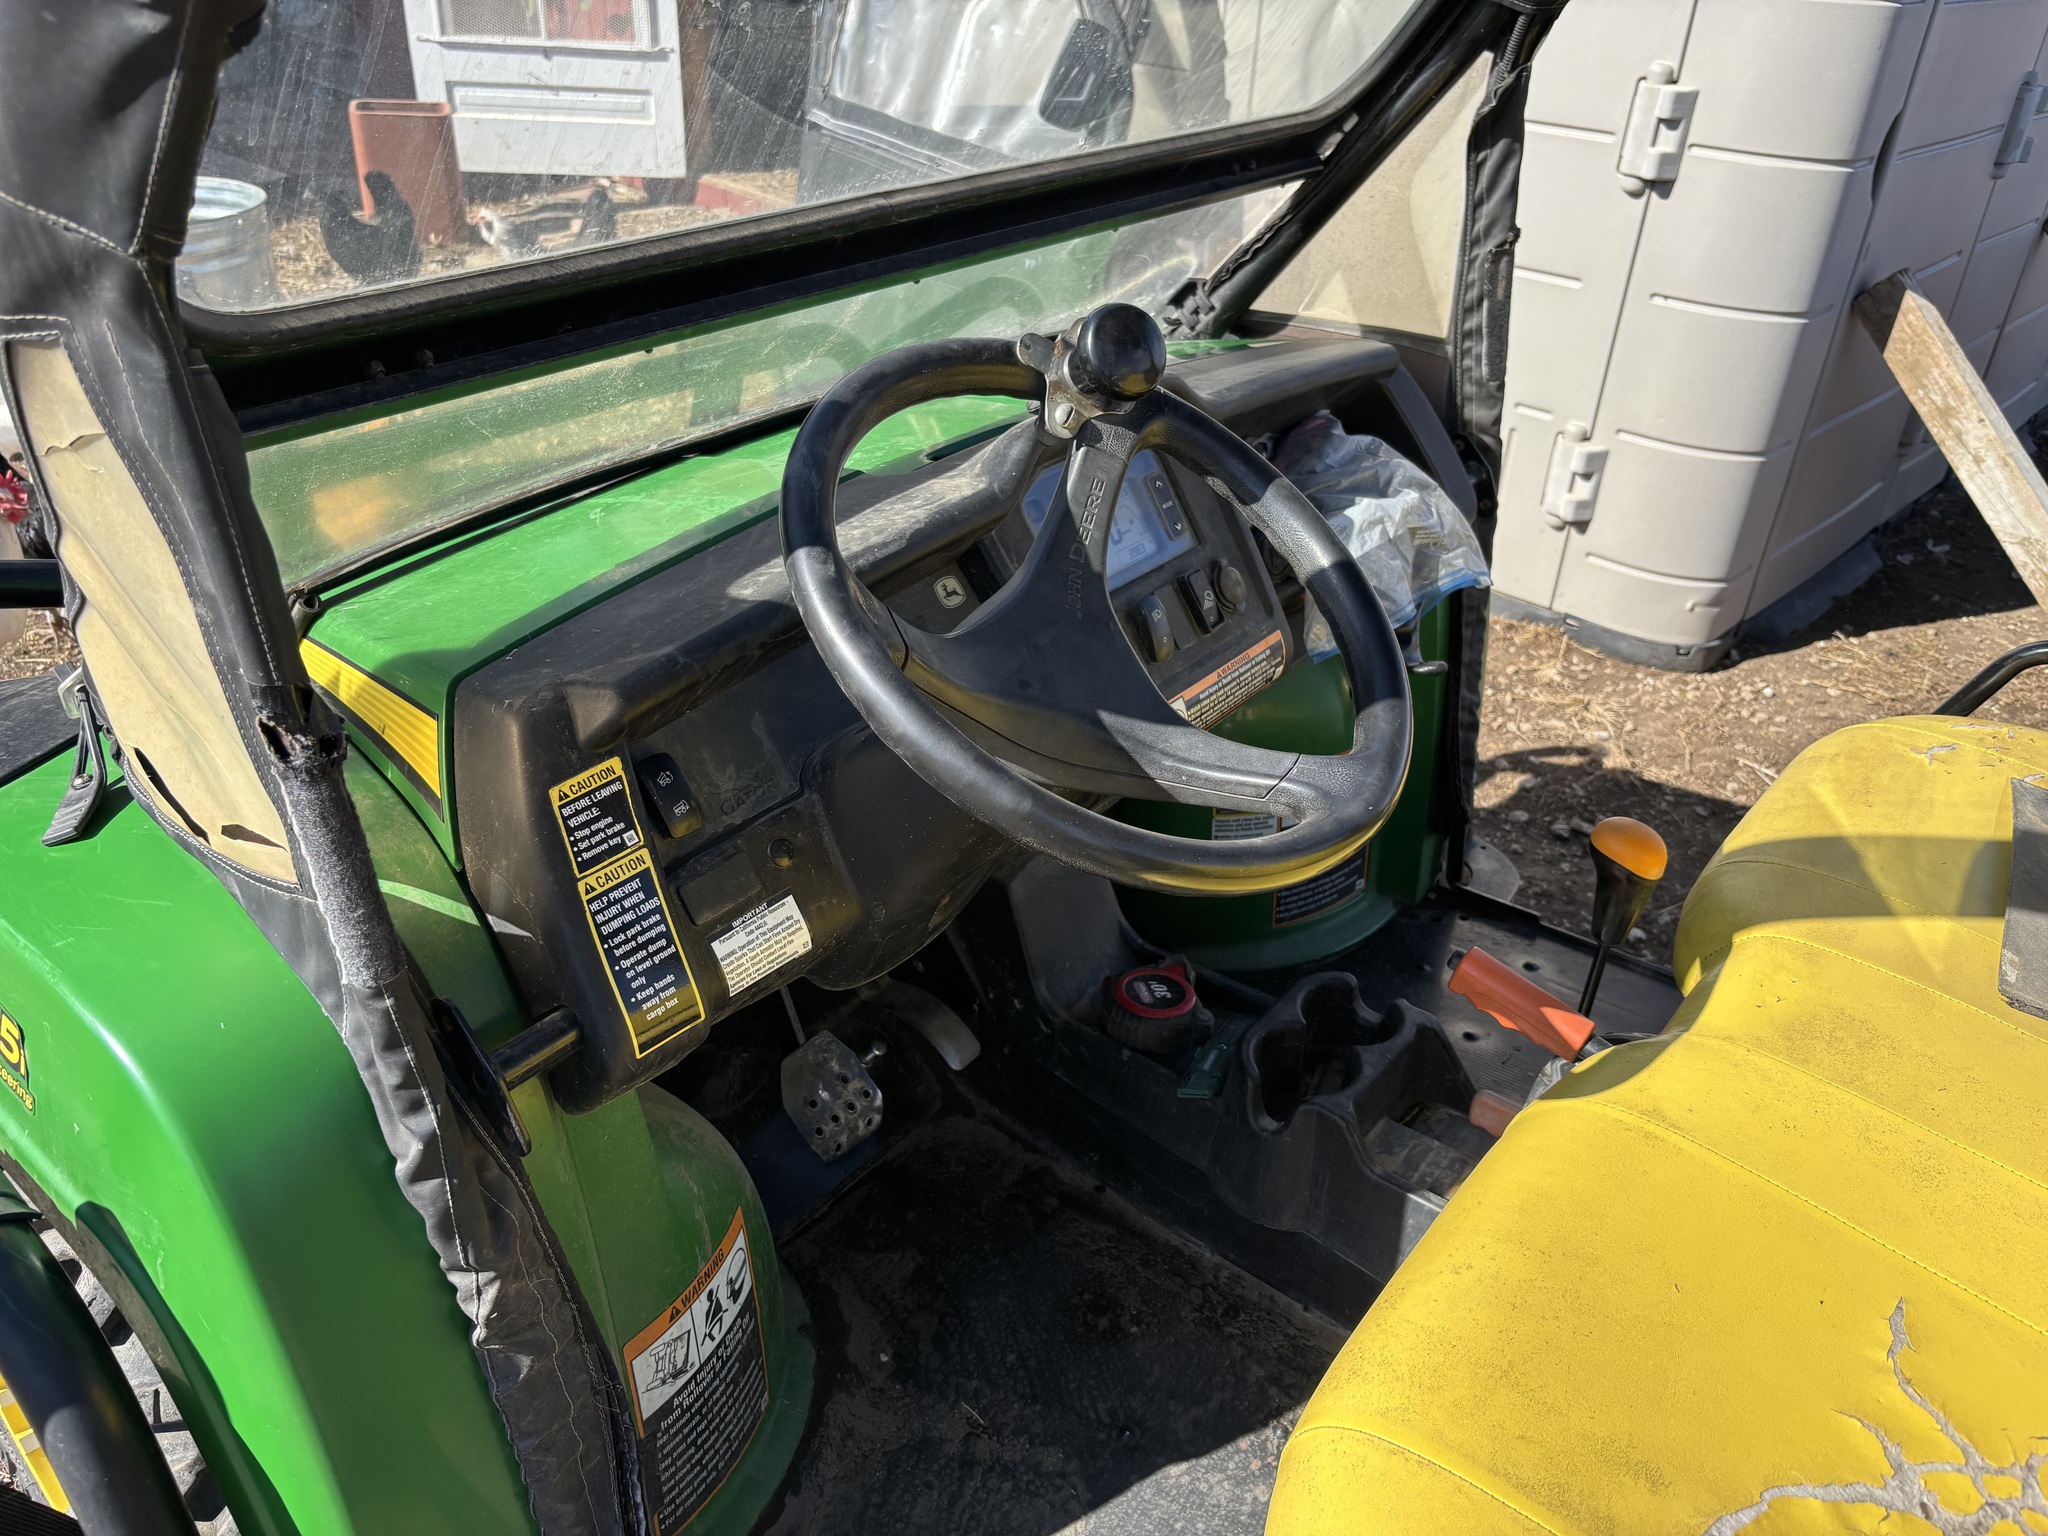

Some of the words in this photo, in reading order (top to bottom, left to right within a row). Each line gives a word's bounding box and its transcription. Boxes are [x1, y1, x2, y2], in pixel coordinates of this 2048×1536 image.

[1069, 478, 1107, 564] DEERE
[1064, 567, 1083, 620] JOHN
[1220, 653, 1250, 675] WARNING
[569, 765, 616, 795] CAUTION
[561, 796, 592, 816] BEFORE
[591, 781, 622, 802] LEAVING
[567, 807, 601, 827] VEHICLE:
[574, 827, 590, 839] Stop
[590, 816, 613, 831] engine
[577, 839, 590, 849] Set
[590, 831, 606, 845] park
[605, 822, 625, 835] brake
[581, 842, 608, 860] Remove
[607, 836, 621, 846] key
[595, 854, 646, 887] CAUTION
[588, 896, 608, 912] HELP
[608, 878, 641, 901] PREVENT
[594, 903, 622, 923] INJURY
[621, 891, 645, 908] WHEN
[600, 910, 636, 935] DUMPING
[635, 896, 660, 915] LOADS
[608, 932, 626, 946] Lock
[625, 923, 642, 938] park
[641, 913, 661, 928] brake
[719, 932, 736, 945] Pursuant
[739, 919, 757, 933] California
[756, 912, 768, 922] Public
[767, 901, 787, 915] Resources
[731, 902, 768, 928] IMPORTANT
[613, 940, 636, 956] before
[636, 923, 666, 943] dumping
[735, 951, 748, 963] Sparks
[747, 946, 757, 954] That
[763, 936, 773, 945] Start
[772, 930, 782, 939] Fires
[738, 938, 756, 952] Operation
[759, 930, 768, 938] This
[767, 919, 787, 933] Equipment
[745, 929, 755, 938] Code
[620, 949, 647, 968] Operate
[647, 938, 666, 952] dump
[625, 969, 635, 978] on
[634, 958, 653, 972] level
[652, 944, 676, 964] ground
[735, 965, 751, 978] Operator
[750, 957, 764, 968] Should
[763, 949, 778, 961] Contact
[776, 943, 788, 952] Local
[749, 952, 760, 962] Spark
[774, 939, 783, 947] May
[631, 976, 646, 988] only
[636, 986, 654, 1000] Keep
[653, 974, 675, 989] hands
[641, 996, 660, 1010] away
[659, 986, 676, 999] from
[646, 1005, 665, 1020] cargo
[665, 997, 678, 1008] box
[681, 1247, 725, 1309] WARNING
[660, 1406, 681, 1430] from
[682, 1370, 714, 1409] Rollover
[716, 1361, 723, 1372] or
[723, 1329, 743, 1361] Falling
[673, 1381, 695, 1409] Avoid
[697, 1357, 717, 1383] Injury
[718, 1343, 725, 1355] or
[725, 1317, 742, 1344] Death
